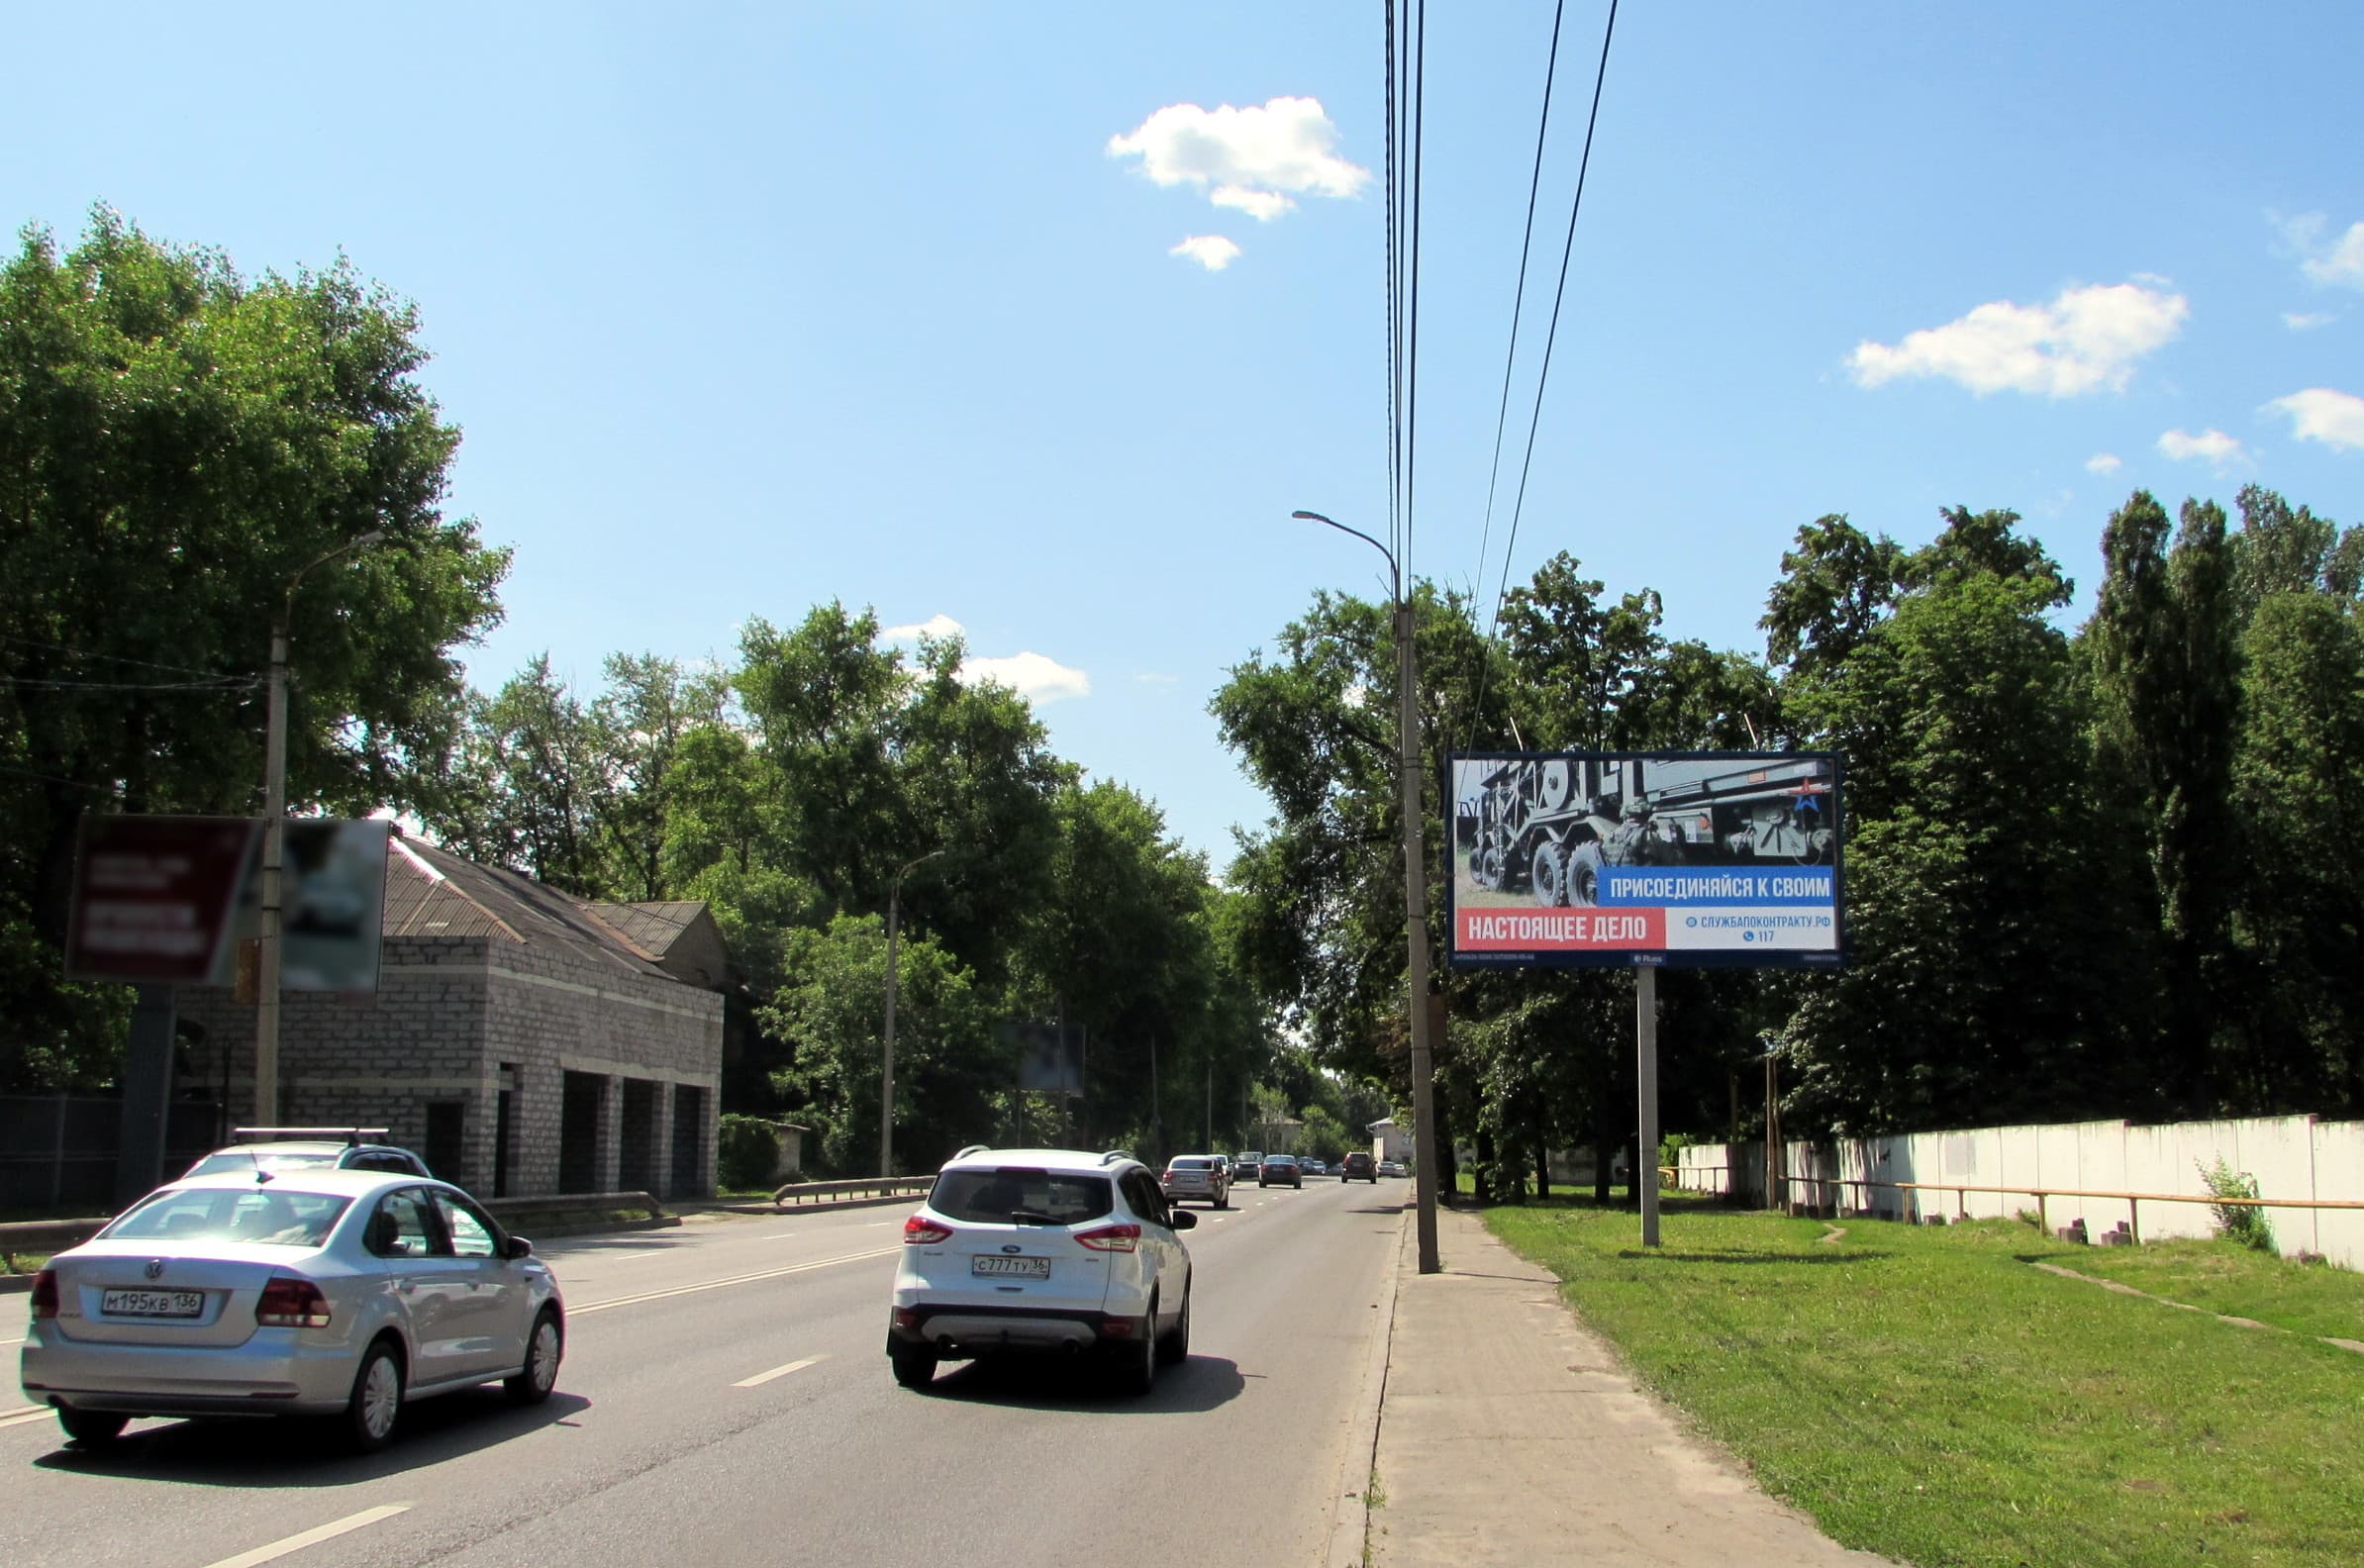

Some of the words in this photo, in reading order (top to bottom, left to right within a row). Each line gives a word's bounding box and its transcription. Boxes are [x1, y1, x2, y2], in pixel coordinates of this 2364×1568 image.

[1610, 874, 1755, 900] ПРИСОЕДИНЯЙСЯ
[1757, 877, 1769, 898] К
[1772, 877, 1830, 898] СВОИМ
[1468, 917, 1587, 942] НАСТОЯЩЕЕ
[1592, 917, 1646, 942] ДЕЛО
[1701, 916, 1830, 929] СЛУЖБАПОКОНТРАКТУ.РФ
[1758, 931, 1774, 942] 117
[173, 1294, 197, 1308] 136
